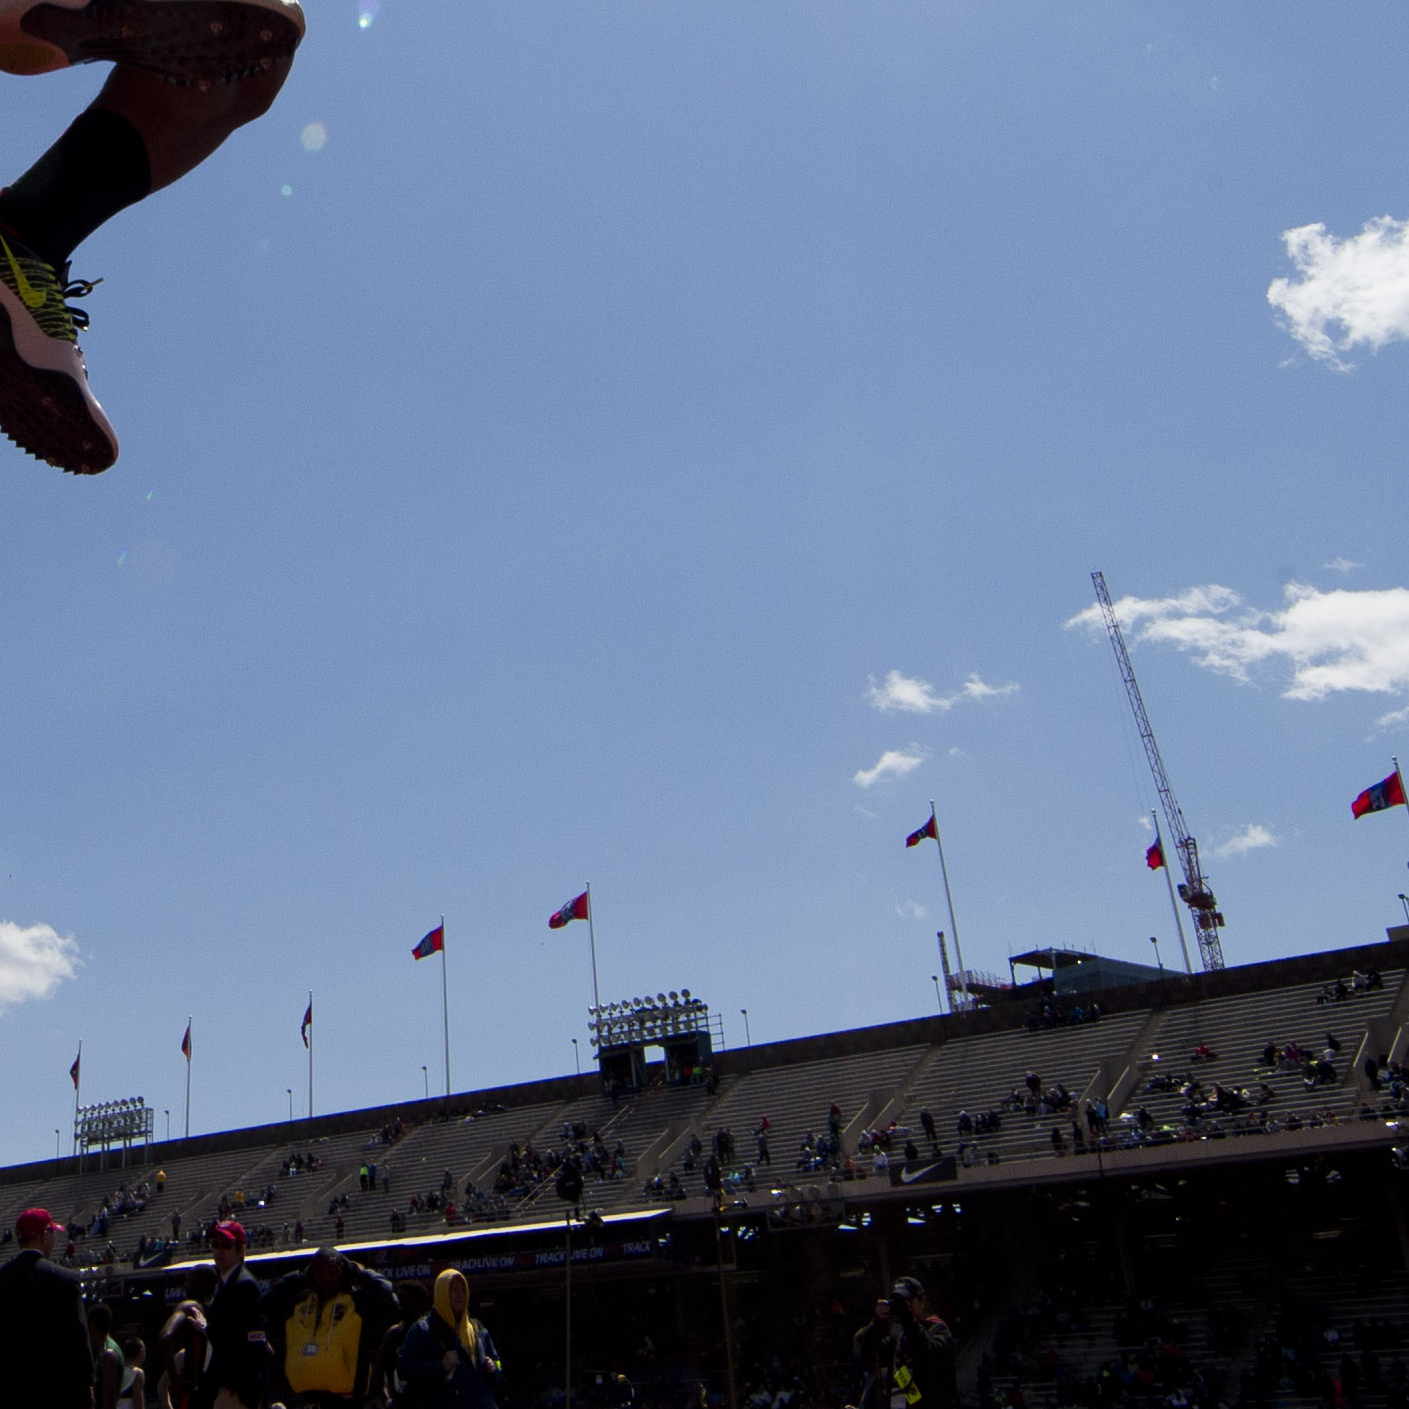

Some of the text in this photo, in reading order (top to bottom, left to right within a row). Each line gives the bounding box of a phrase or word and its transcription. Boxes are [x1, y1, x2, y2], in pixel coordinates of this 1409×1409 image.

[589, 1246, 605, 1260] ON
[476, 1256, 499, 1270] LIVE
[499, 1255, 515, 1268] ON
[396, 1264, 416, 1278] LIVE
